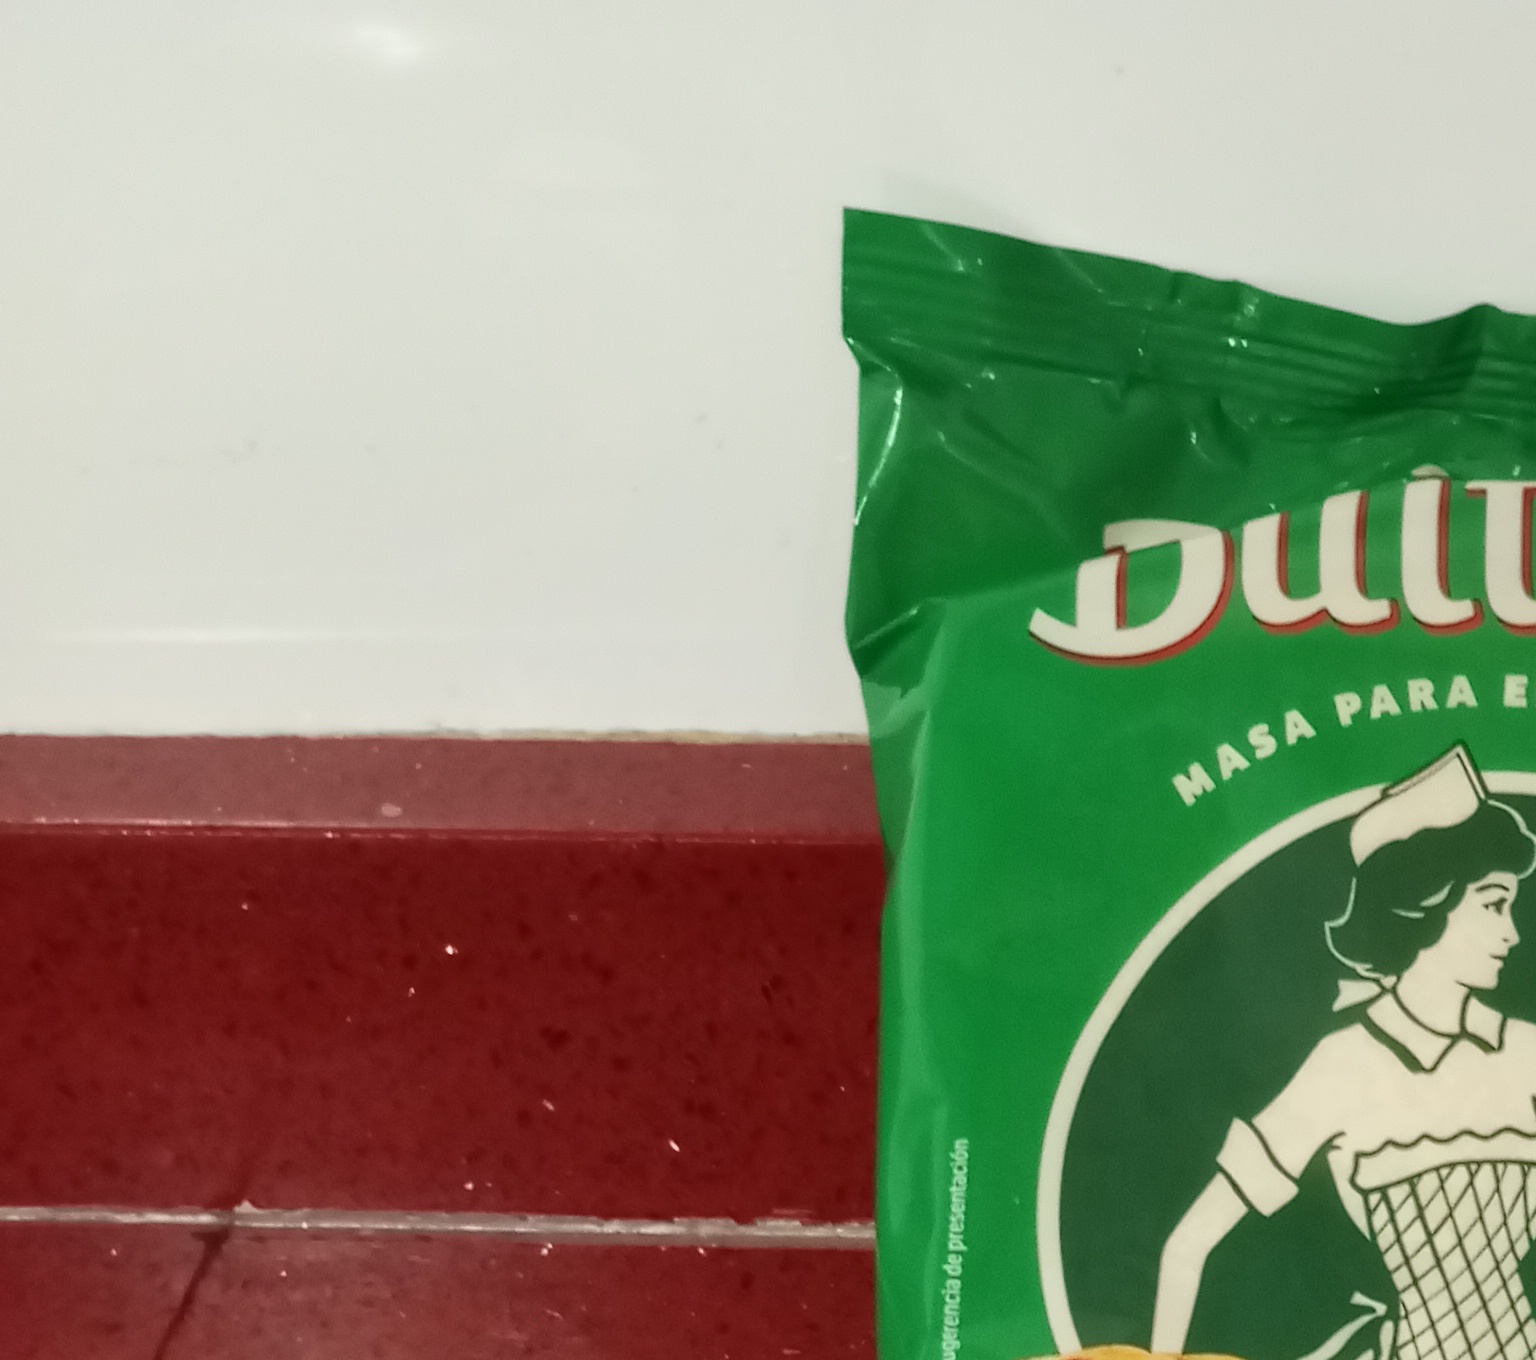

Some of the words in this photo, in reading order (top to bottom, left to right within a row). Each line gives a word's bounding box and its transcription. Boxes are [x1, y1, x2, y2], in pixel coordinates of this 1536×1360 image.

[1172, 709, 1316, 806] MASA
[1333, 674, 1478, 727] PARA
[949, 1137, 970, 1252] presentación
[943, 1253, 963, 1277] de
